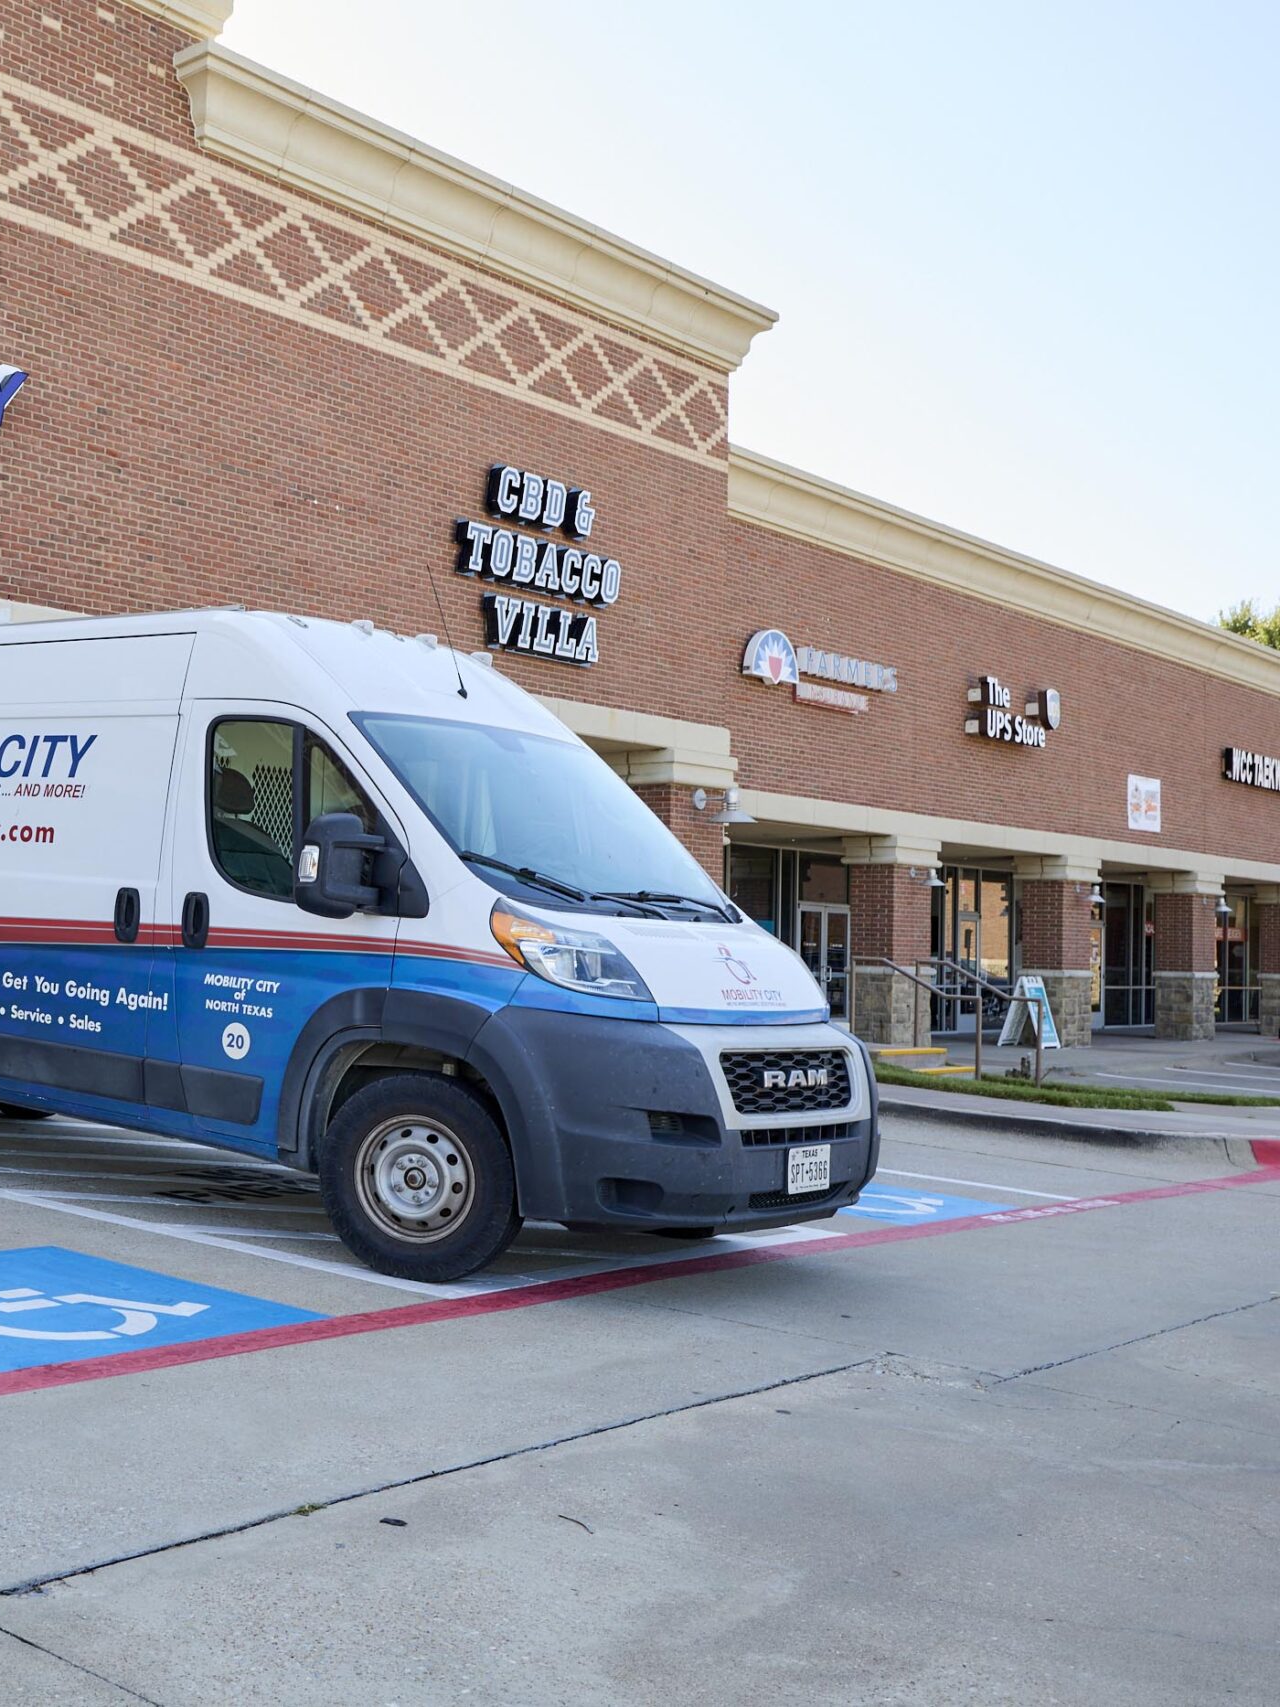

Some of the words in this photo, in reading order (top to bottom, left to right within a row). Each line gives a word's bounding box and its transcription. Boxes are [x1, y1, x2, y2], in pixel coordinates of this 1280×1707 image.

[496, 466, 567, 527] CBD
[574, 490, 596, 536] &
[466, 520, 621, 604] TOBACCO
[494, 595, 599, 663] VILLA
[804, 646, 898, 693] FARMERS
[986, 676, 1011, 709] The
[986, 708, 1013, 741] UPS
[1014, 715, 1046, 748] Store
[1232, 747, 1253, 785] WCC
[14, 783, 41, 797] AND
[43, 784, 86, 798] MORE!
[2, 971, 28, 990] Get
[34, 975, 60, 995] You
[65, 980, 110, 1007] Going
[115, 987, 169, 1011] Again!
[203, 973, 255, 990] MOBILITY
[255, 980, 280, 994] CITY
[233, 989, 247, 1001] of
[721, 988, 763, 1001] MOBILITY
[764, 989, 783, 1001] CITY
[10, 1005, 52, 1024] Service
[69, 1013, 102, 1033] Sales
[205, 999, 240, 1014] NORTH
[242, 1004, 273, 1018] TEXAS
[226, 1033, 244, 1050] 20
[763, 1069, 828, 1088] RAM
[802, 1149, 818, 1158] TEXAS
